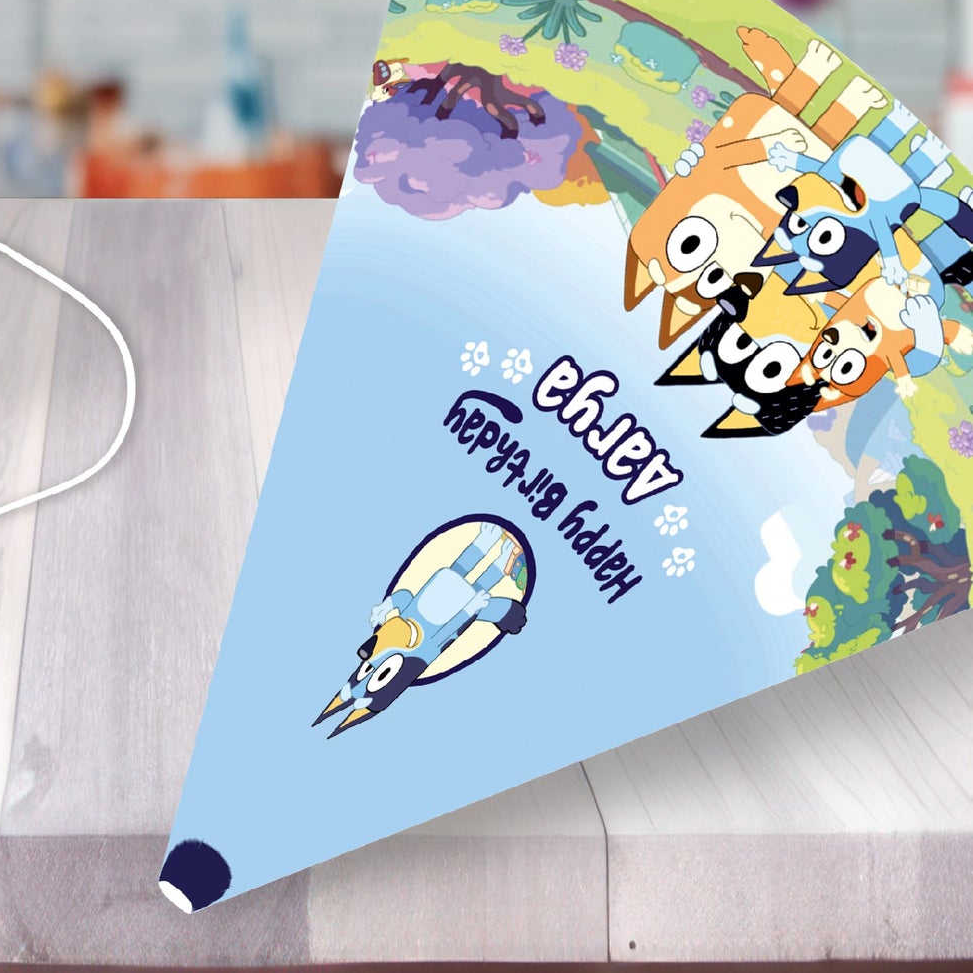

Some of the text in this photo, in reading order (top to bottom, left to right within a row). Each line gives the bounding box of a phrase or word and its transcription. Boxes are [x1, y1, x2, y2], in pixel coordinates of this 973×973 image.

[443, 389, 643, 605] Happy Birthday
[531, 354, 684, 506] Aarya
